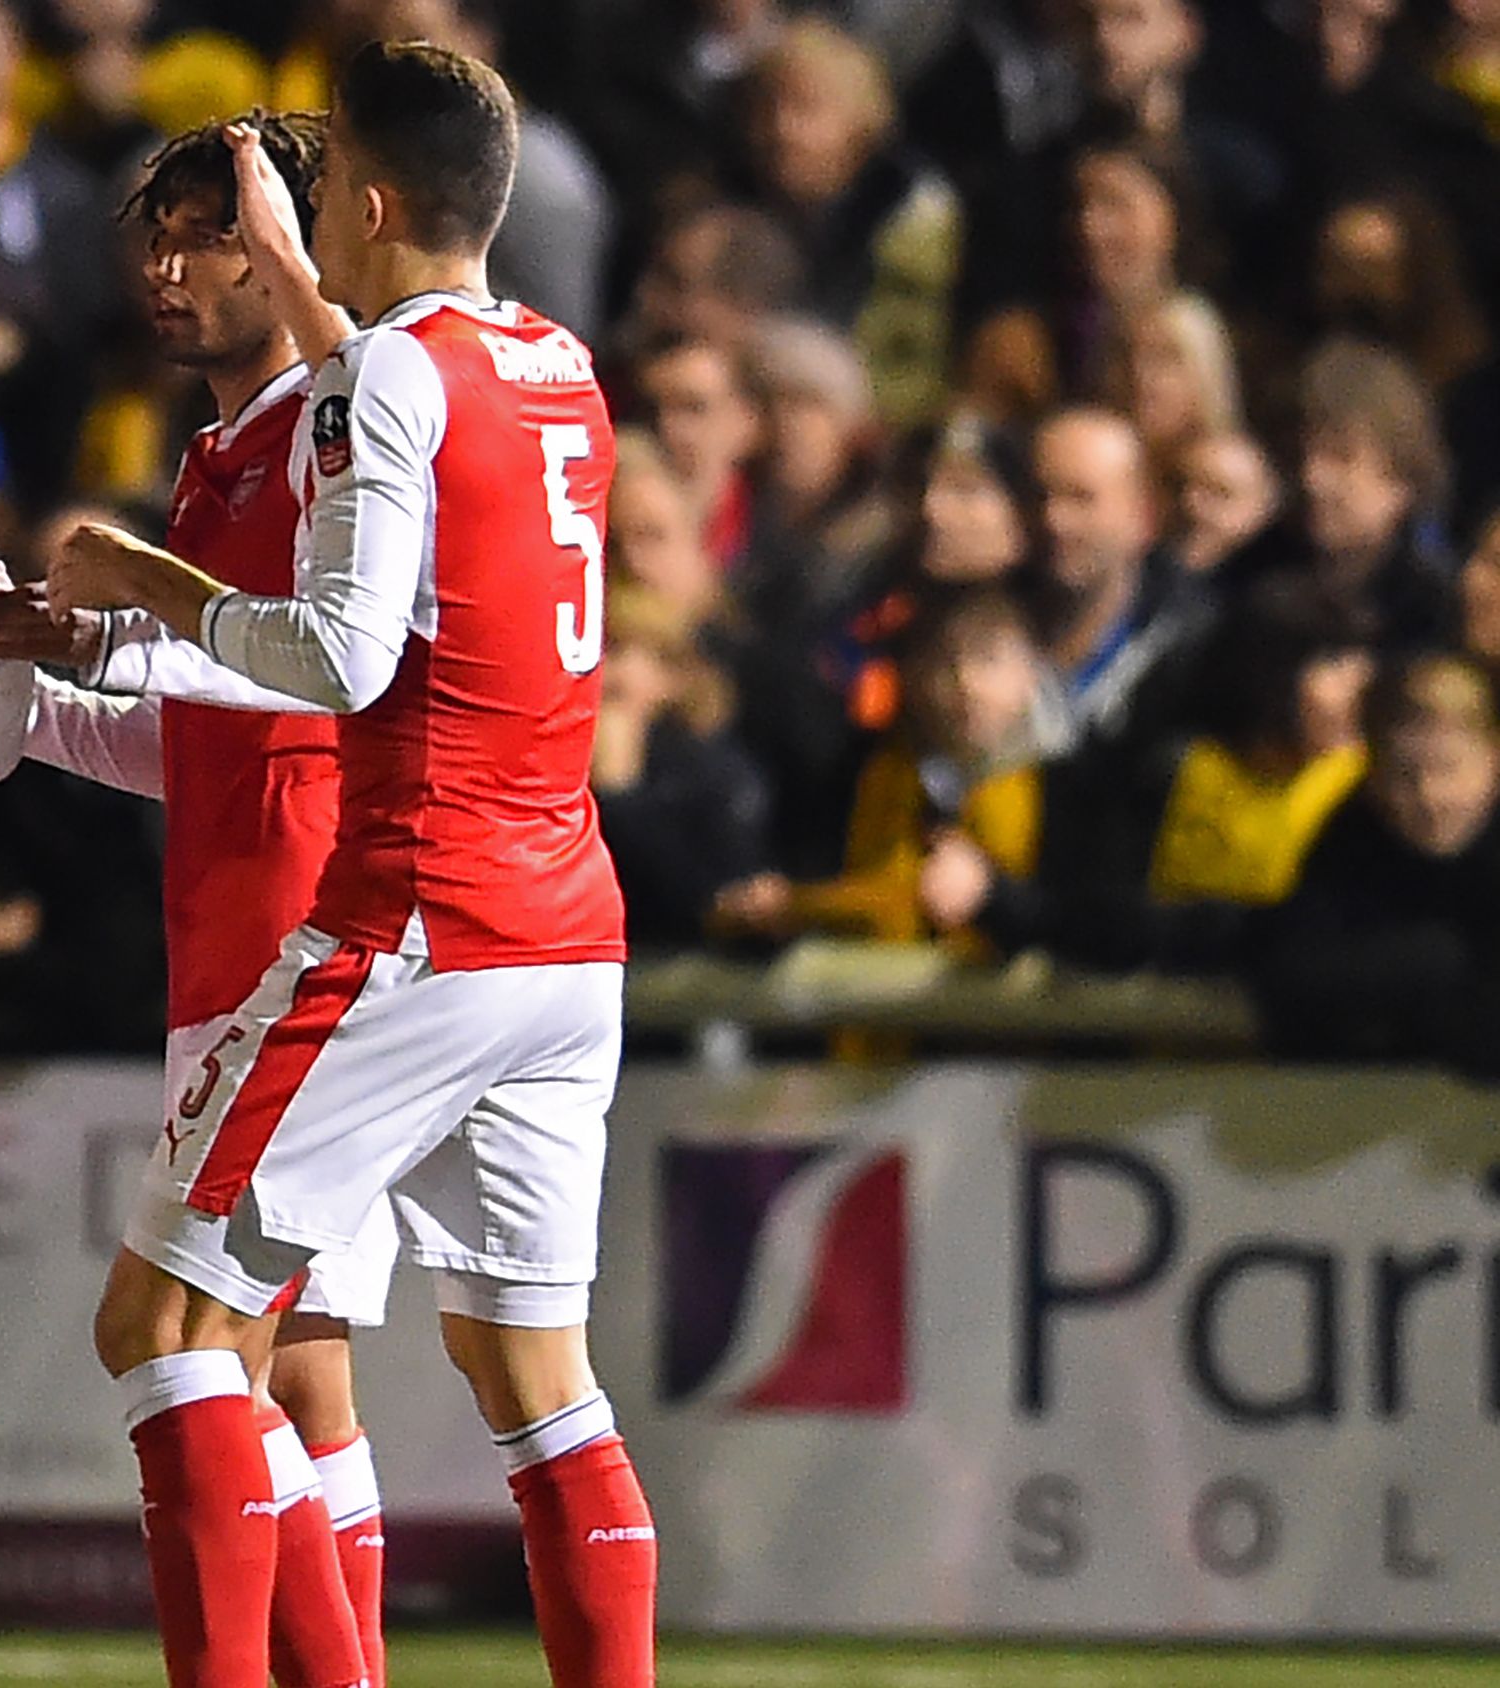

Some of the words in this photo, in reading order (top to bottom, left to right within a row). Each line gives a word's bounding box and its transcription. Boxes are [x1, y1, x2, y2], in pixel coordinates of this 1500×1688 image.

[539, 424, 604, 675] 5
[179, 1024, 247, 1119] 5
[1011, 1473, 1440, 1580] SOL
